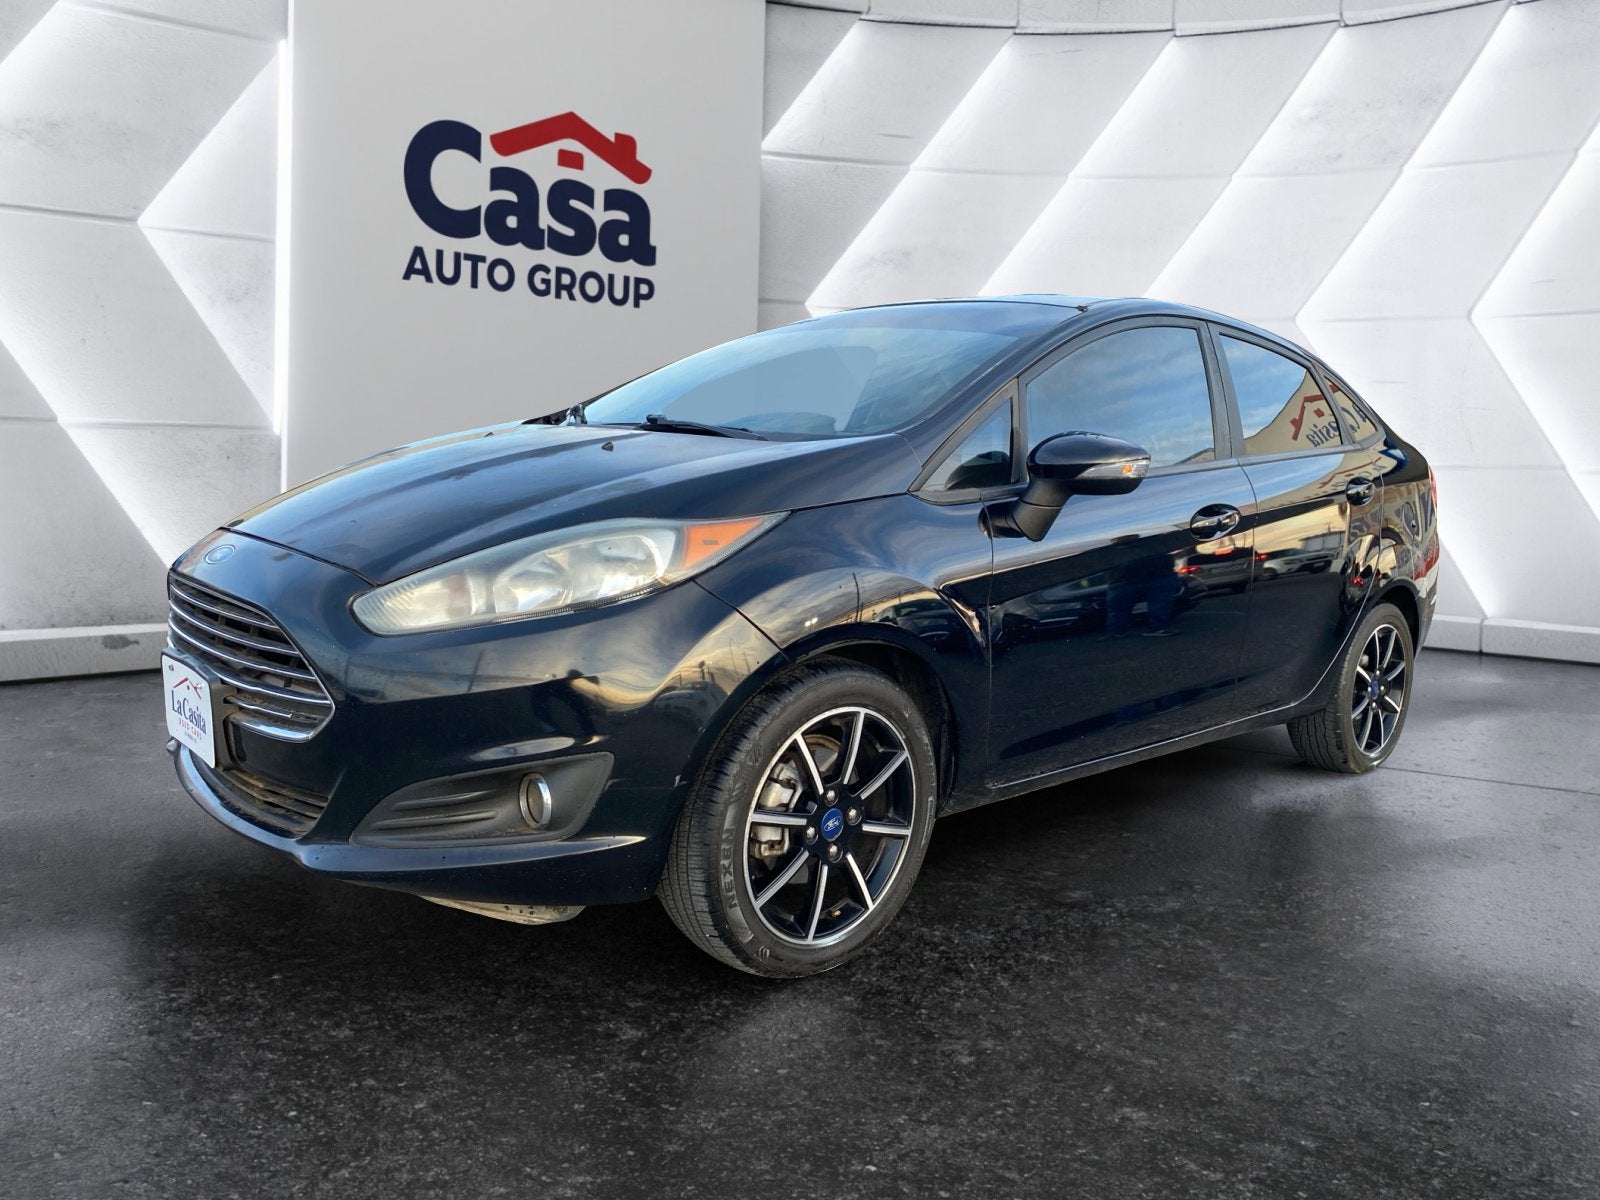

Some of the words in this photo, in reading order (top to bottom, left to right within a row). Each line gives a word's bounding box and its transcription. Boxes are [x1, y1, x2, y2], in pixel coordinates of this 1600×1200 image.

[404, 119, 657, 266] Casa
[402, 245, 515, 292] AUTO
[527, 263, 655, 308] GROUP
[720, 828, 738, 910] NEXEN
